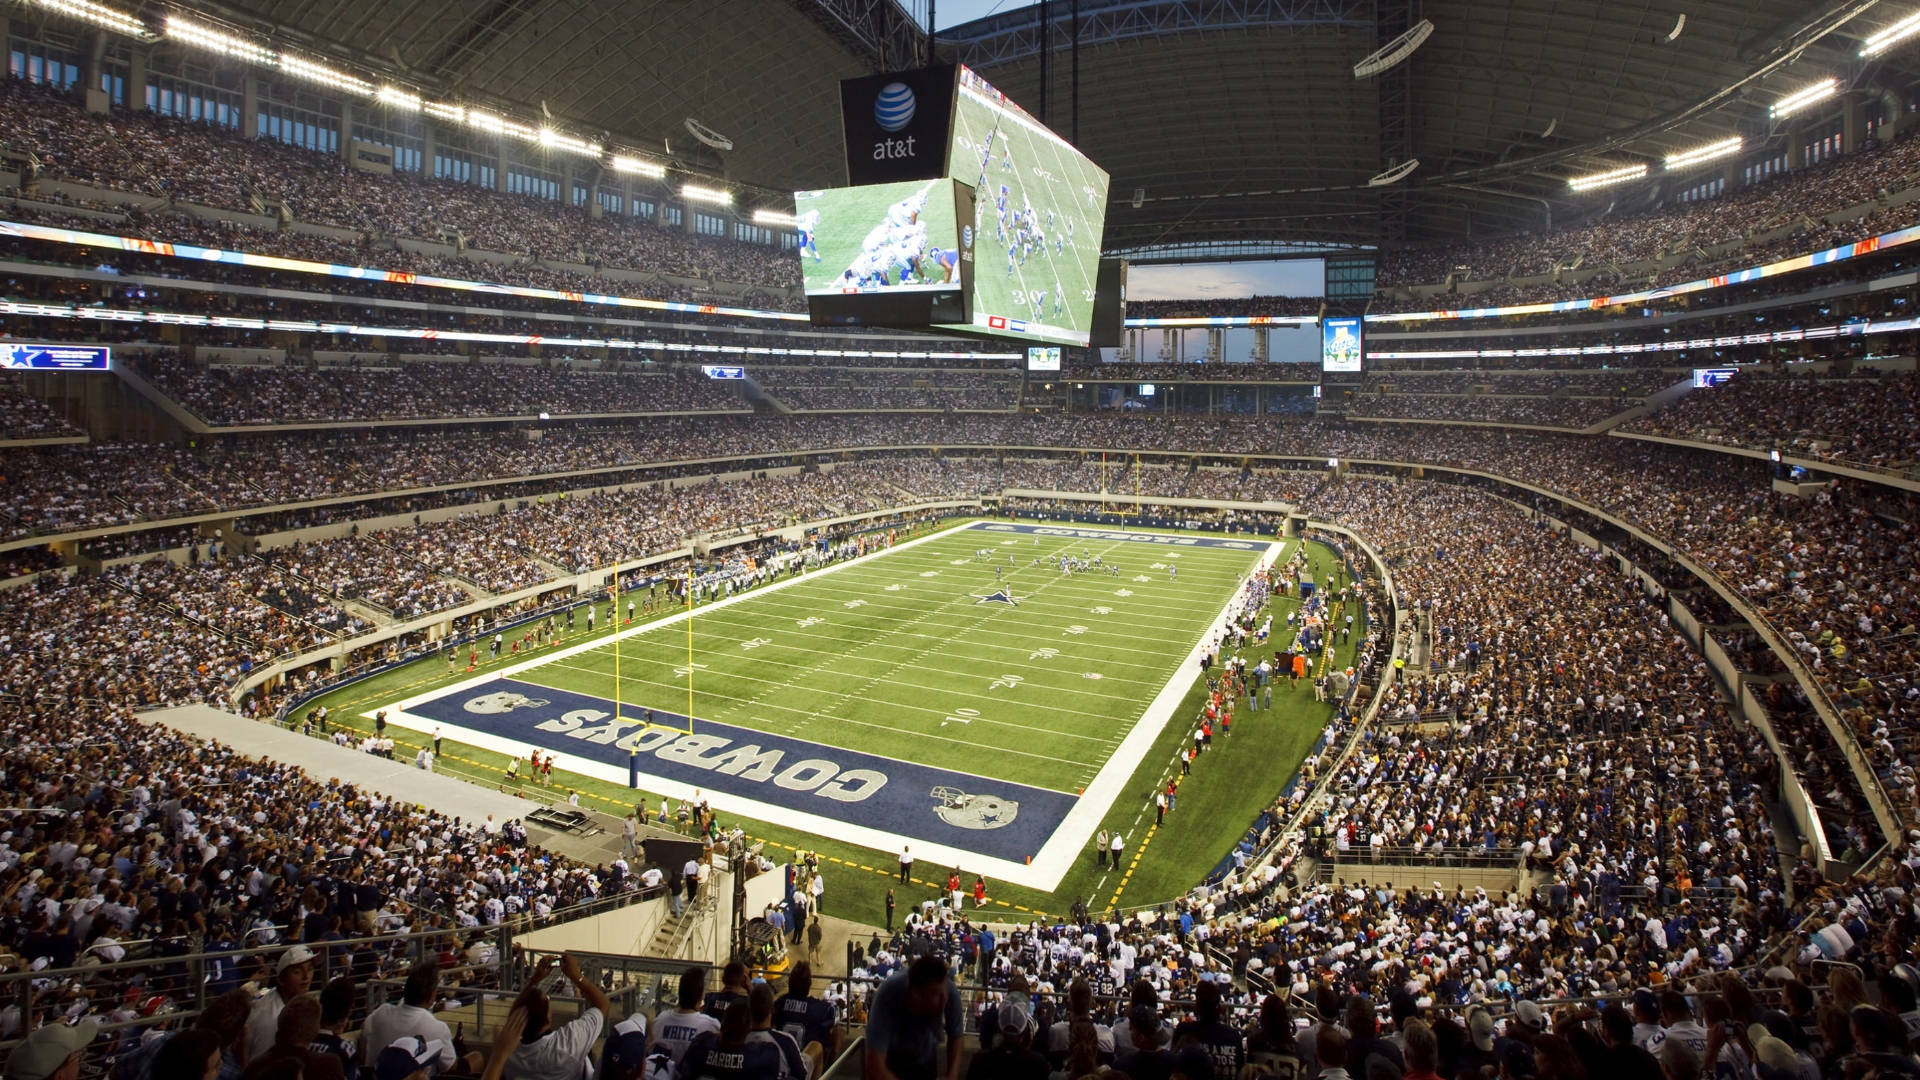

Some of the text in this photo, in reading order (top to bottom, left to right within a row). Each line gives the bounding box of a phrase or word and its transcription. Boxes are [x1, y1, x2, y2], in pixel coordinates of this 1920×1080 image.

[873, 135, 916, 160] at&t
[533, 709, 889, 802] COWBOYS
[784, 999, 808, 1014] ROMO
[662, 1024, 698, 1042] WHITE
[705, 1050, 745, 1070] BARBER
